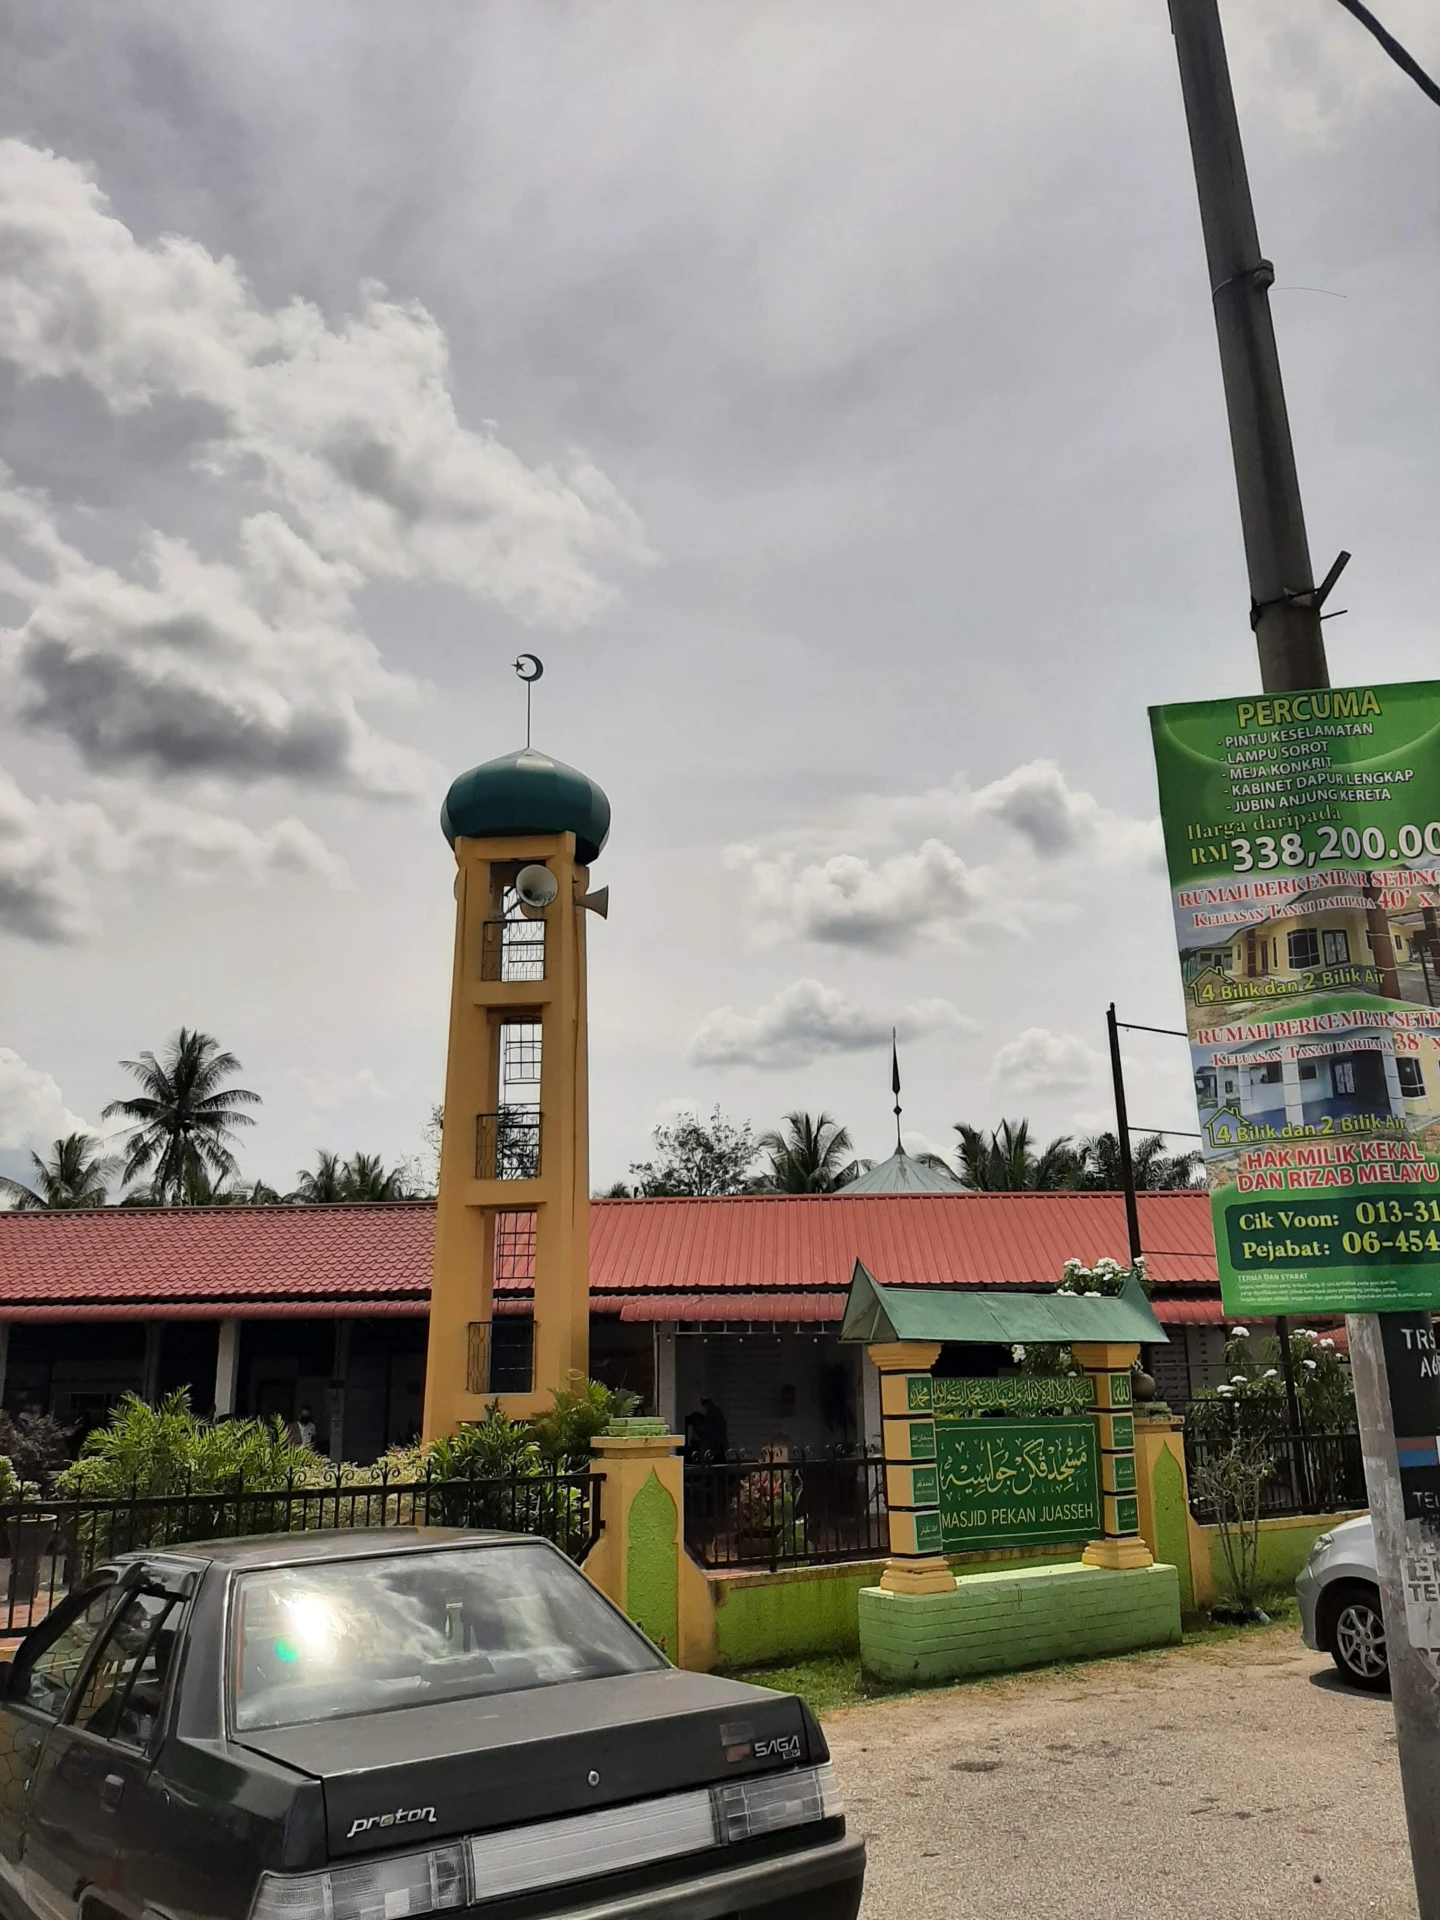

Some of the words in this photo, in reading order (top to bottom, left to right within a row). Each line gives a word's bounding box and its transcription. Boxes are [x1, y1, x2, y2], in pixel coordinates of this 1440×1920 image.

[1237, 689, 1381, 728] PERCUMA
[1225, 732, 1268, 748] PINTU
[1270, 722, 1374, 743] KESELAMATAN
[1227, 748, 1278, 764] LAMPU
[1281, 741, 1329, 757] SOROT
[1229, 764, 1268, 780] MEJA
[1270, 756, 1333, 776] KONKRIT
[1231, 780, 1293, 797] KABINET
[1296, 773, 1344, 789] DAPUR
[1346, 769, 1414, 786] LENGKAP
[1233, 798, 1276, 813] JUBIN
[1279, 789, 1337, 808] ANJUNG
[1340, 788, 1392, 802] KERETA
[1187, 817, 1247, 840] Harga
[1252, 804, 1342, 833] daripada
[1178, 881, 1250, 909] RUMAH
[1253, 870, 1369, 898] BERKEMBAR
[1317, 897, 1377, 912] DARIPADA
[1201, 984, 1216, 1002] 4
[1221, 983, 1261, 1001] Bilik
[1264, 975, 1299, 995] dan
[1302, 971, 1317, 991] 2
[1322, 967, 1362, 988] Bilik
[1364, 969, 1386, 985] Air
[1197, 1022, 1271, 1046] RUMAH
[1273, 1010, 1391, 1037] BERKEMBAR
[1337, 1037, 1393, 1052] DARIPADA
[1217, 1124, 1231, 1144] 4
[1236, 1124, 1277, 1142] Bilik
[1280, 1120, 1316, 1139] dan
[1319, 1115, 1335, 1135] 2
[1341, 1113, 1382, 1132] Bilik
[1385, 1115, 1406, 1130] Air
[1246, 1149, 1292, 1171] HAK
[1295, 1143, 1360, 1169] MILIK
[1361, 1140, 1425, 1162] KEKAL
[1236, 1169, 1285, 1193] DAN
[1288, 1167, 1354, 1189] RIZAB
[1358, 1163, 1439, 1184] MELAYU
[1239, 1212, 1275, 1232] Cik
[1277, 1211, 1340, 1229] Voon:
[1263, 1273, 1280, 1281] DAN
[941, 1511, 987, 1530] MASJID
[991, 1507, 1036, 1525] PEKAN
[1040, 1502, 1094, 1522] JUASSEH
[754, 1735, 800, 1758] SAGA
[346, 1805, 437, 1839] proton
